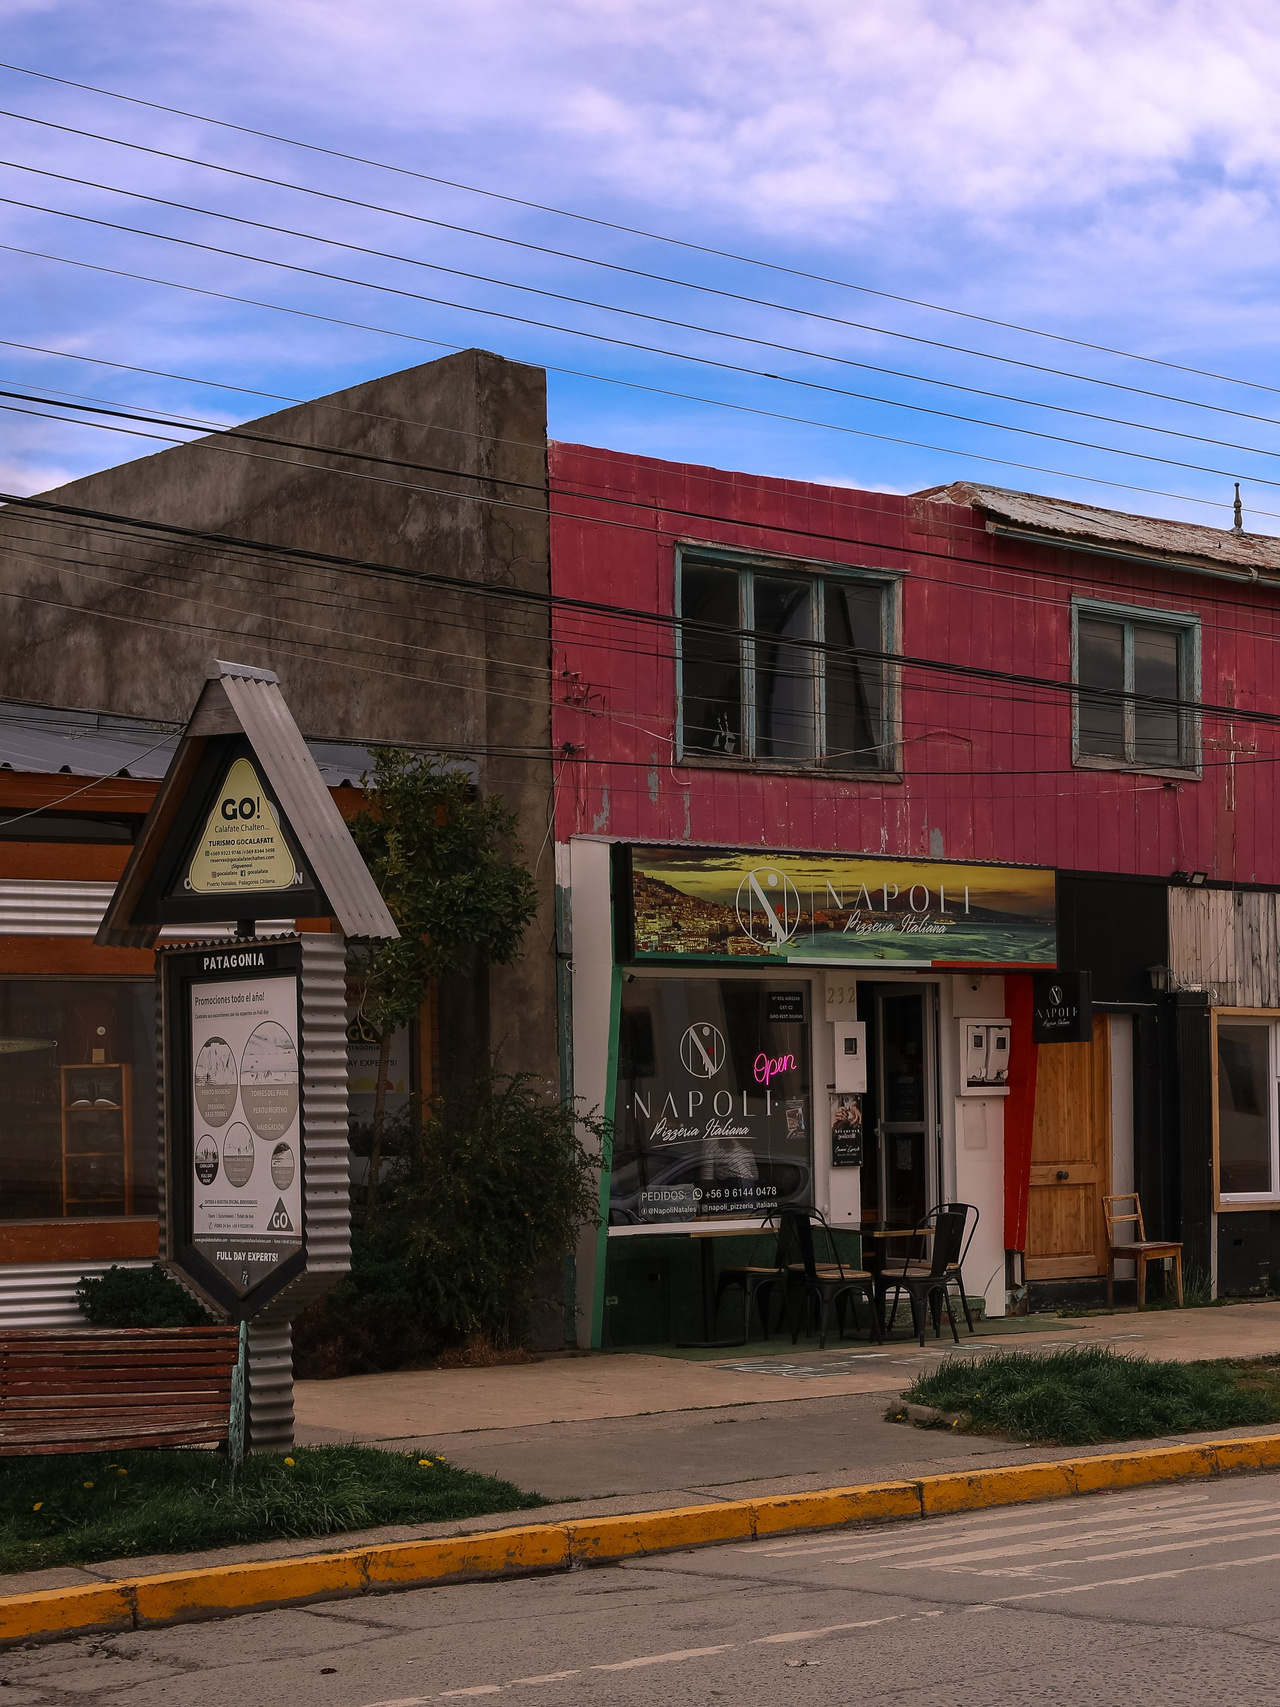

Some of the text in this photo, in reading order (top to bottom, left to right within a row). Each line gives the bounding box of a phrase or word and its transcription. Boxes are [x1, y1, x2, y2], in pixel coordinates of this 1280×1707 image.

[221, 796, 260, 821] GO!
[215, 824, 239, 833] Calafate
[236, 837, 274, 845] GOCALAFATE
[826, 879, 971, 914] NAPOLI
[842, 910, 948, 936] Pizzeria Italiana
[204, 953, 264, 970] PATAGONIA
[195, 992, 265, 1006] Promociones todo el año!
[827, 986, 856, 1005] 232
[753, 1052, 797, 1085] Open
[634, 1089, 773, 1118] NAPOLI
[650, 1117, 750, 1141] Pizzeria Italiana
[641, 1186, 777, 1202] PEDIDOS: +56 9 6144 0478
[708, 1201, 778, 1212] napoli_pizzeria_italiana
[272, 1212, 288, 1229] GO
[216, 1252, 278, 1262] FULL DAY EXPERTS!
